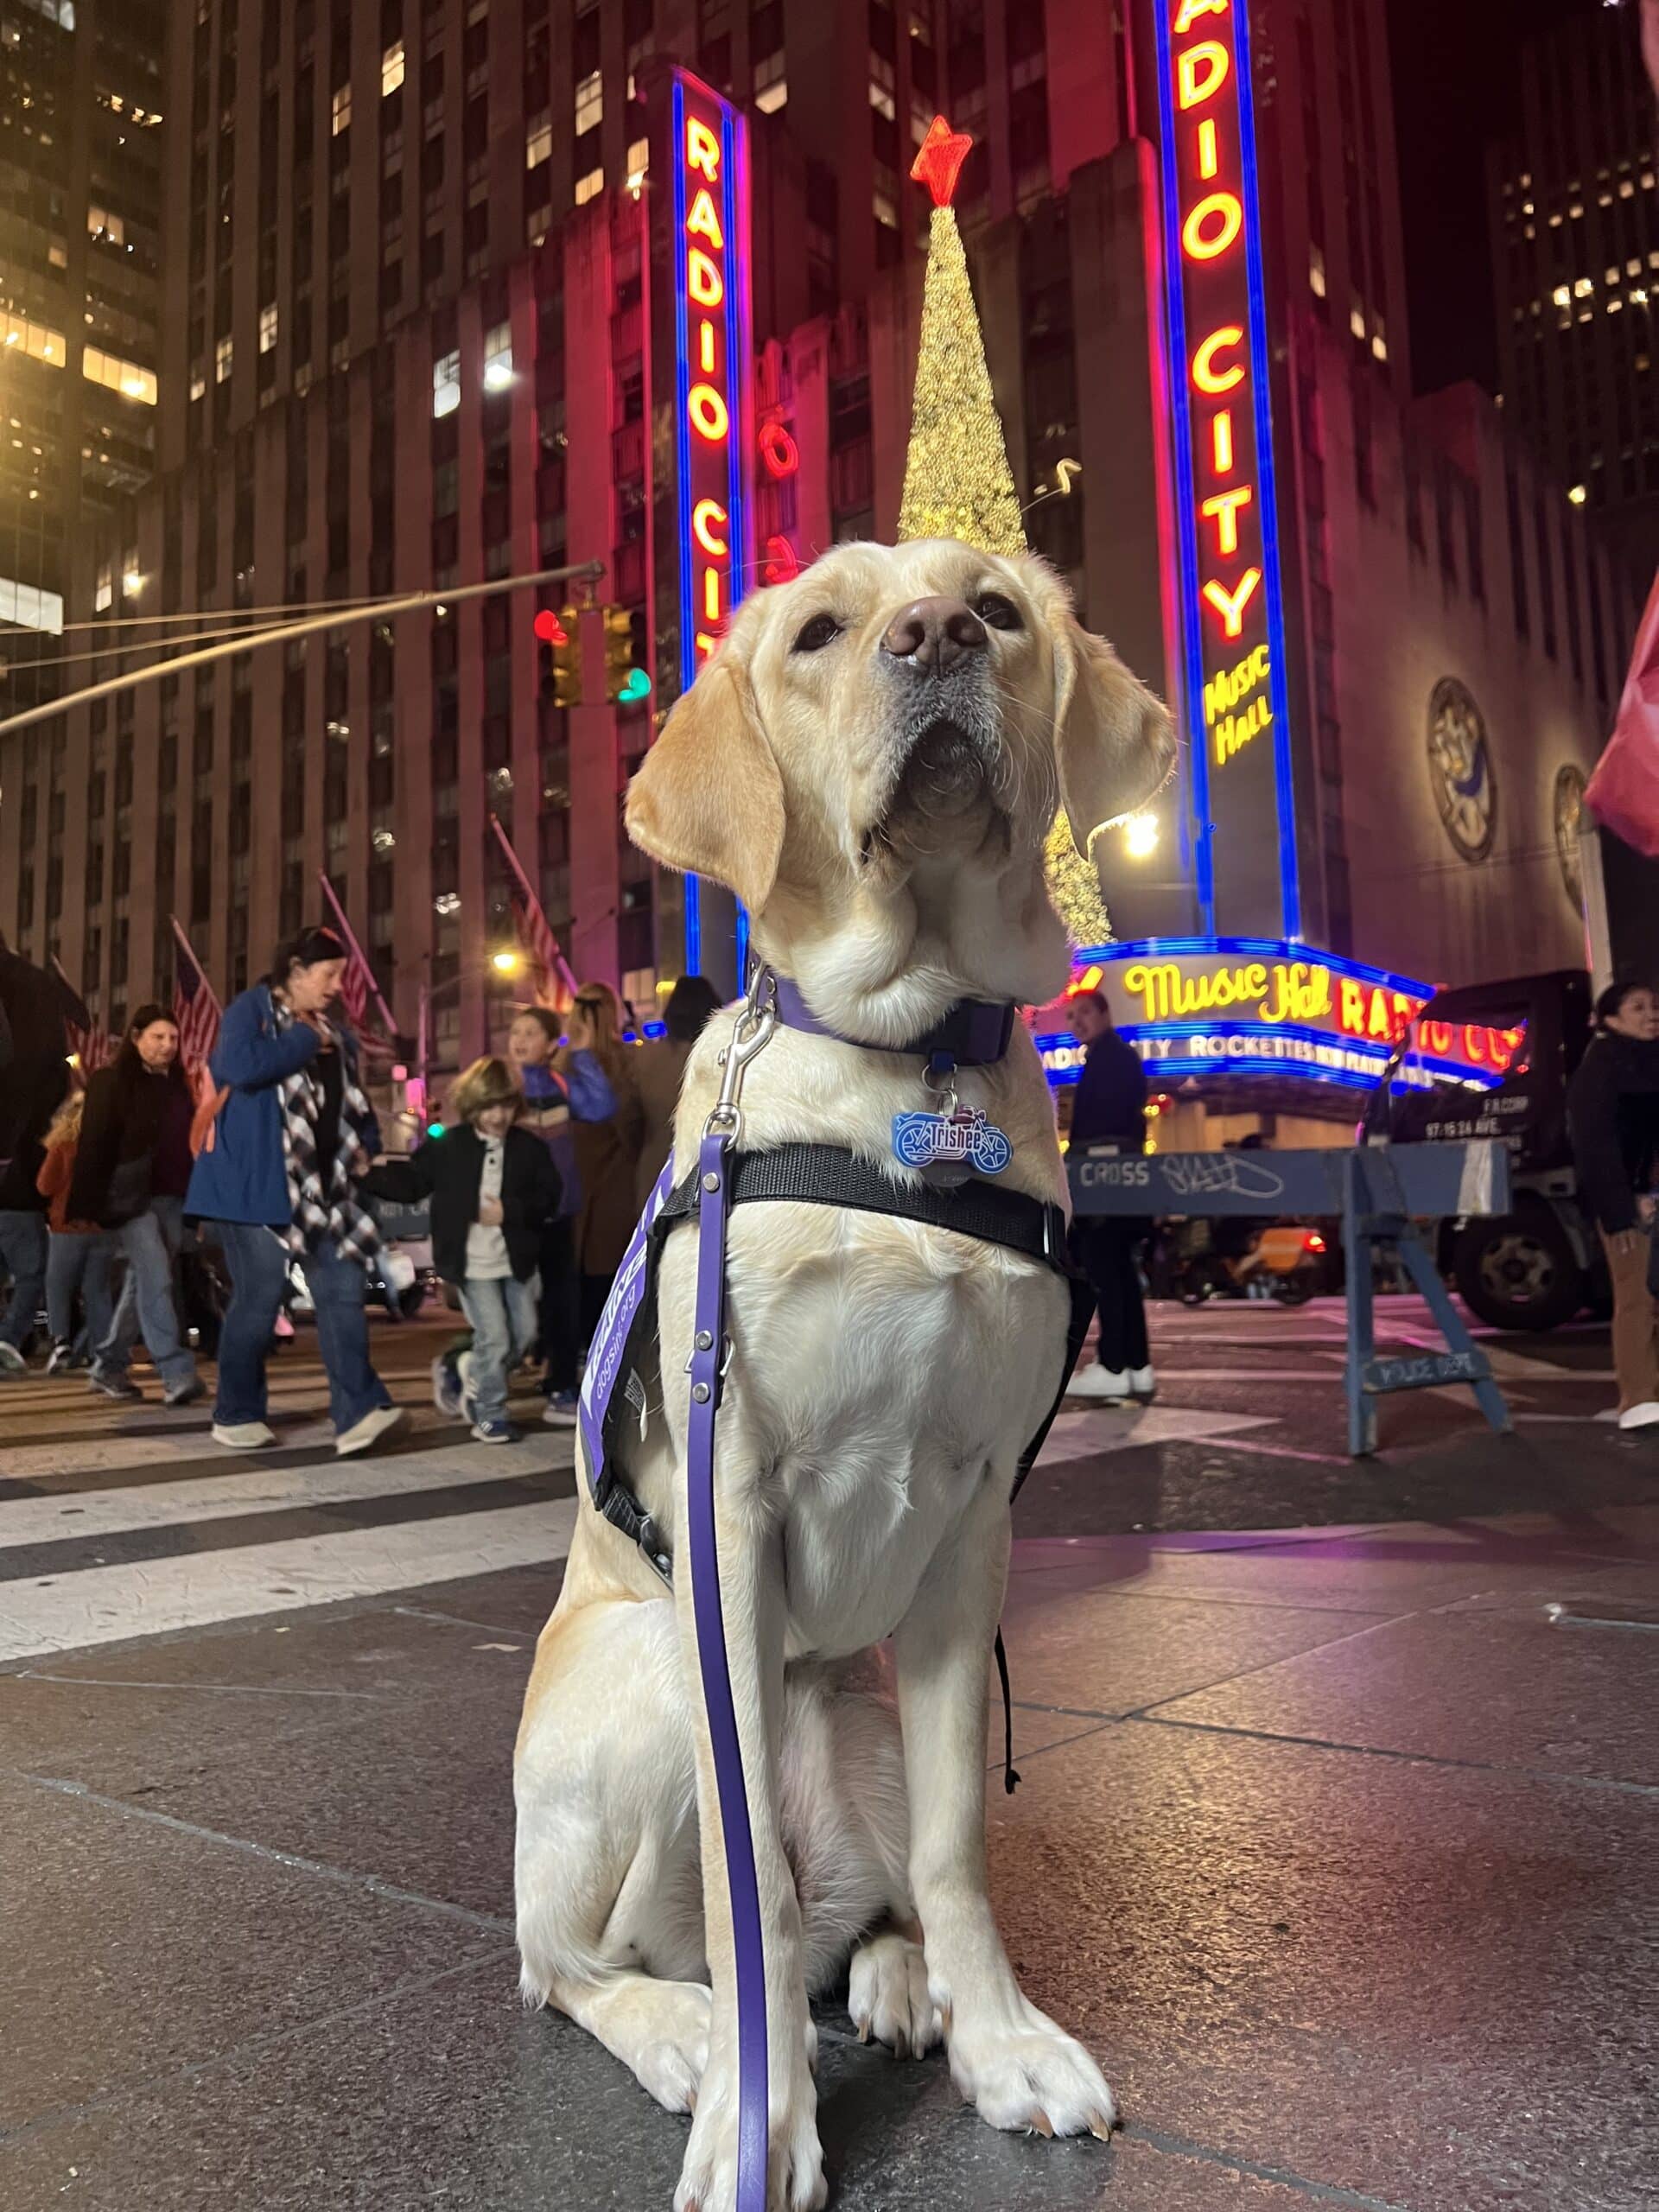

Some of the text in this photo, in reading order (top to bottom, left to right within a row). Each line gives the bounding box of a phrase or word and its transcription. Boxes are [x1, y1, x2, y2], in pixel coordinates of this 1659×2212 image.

[686, 115, 728, 442] RADIO
[1192, 326, 1262, 638] CITY
[931, 1123, 982, 1151] Trishee
[1079, 1161, 1150, 1187] CROSS
